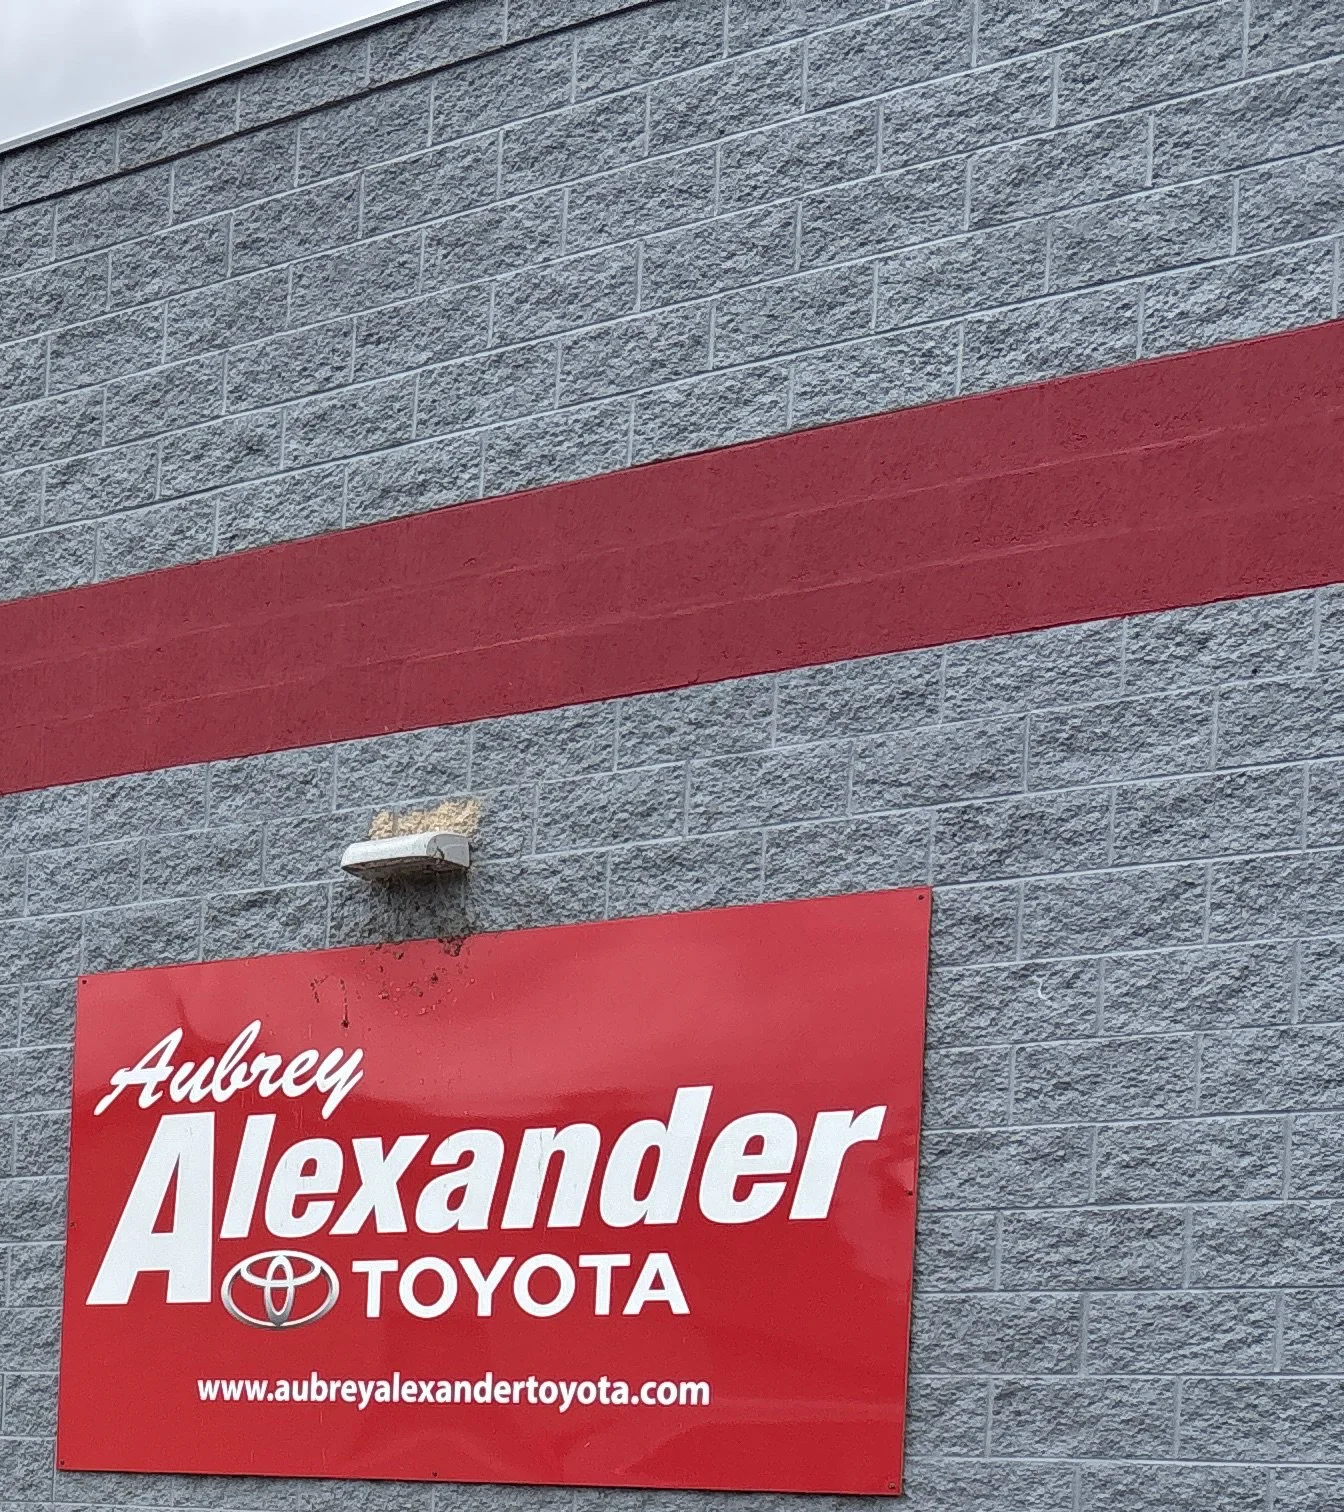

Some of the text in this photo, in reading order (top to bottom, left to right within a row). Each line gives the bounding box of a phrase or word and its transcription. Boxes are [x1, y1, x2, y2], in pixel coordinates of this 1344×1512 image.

[93, 1019, 364, 1119] Aubrey
[86, 1085, 888, 1306] Alexander
[351, 1252, 690, 1319] TOYOTA
[197, 1371, 710, 1413] www.aubreyalexandertoyota.com
